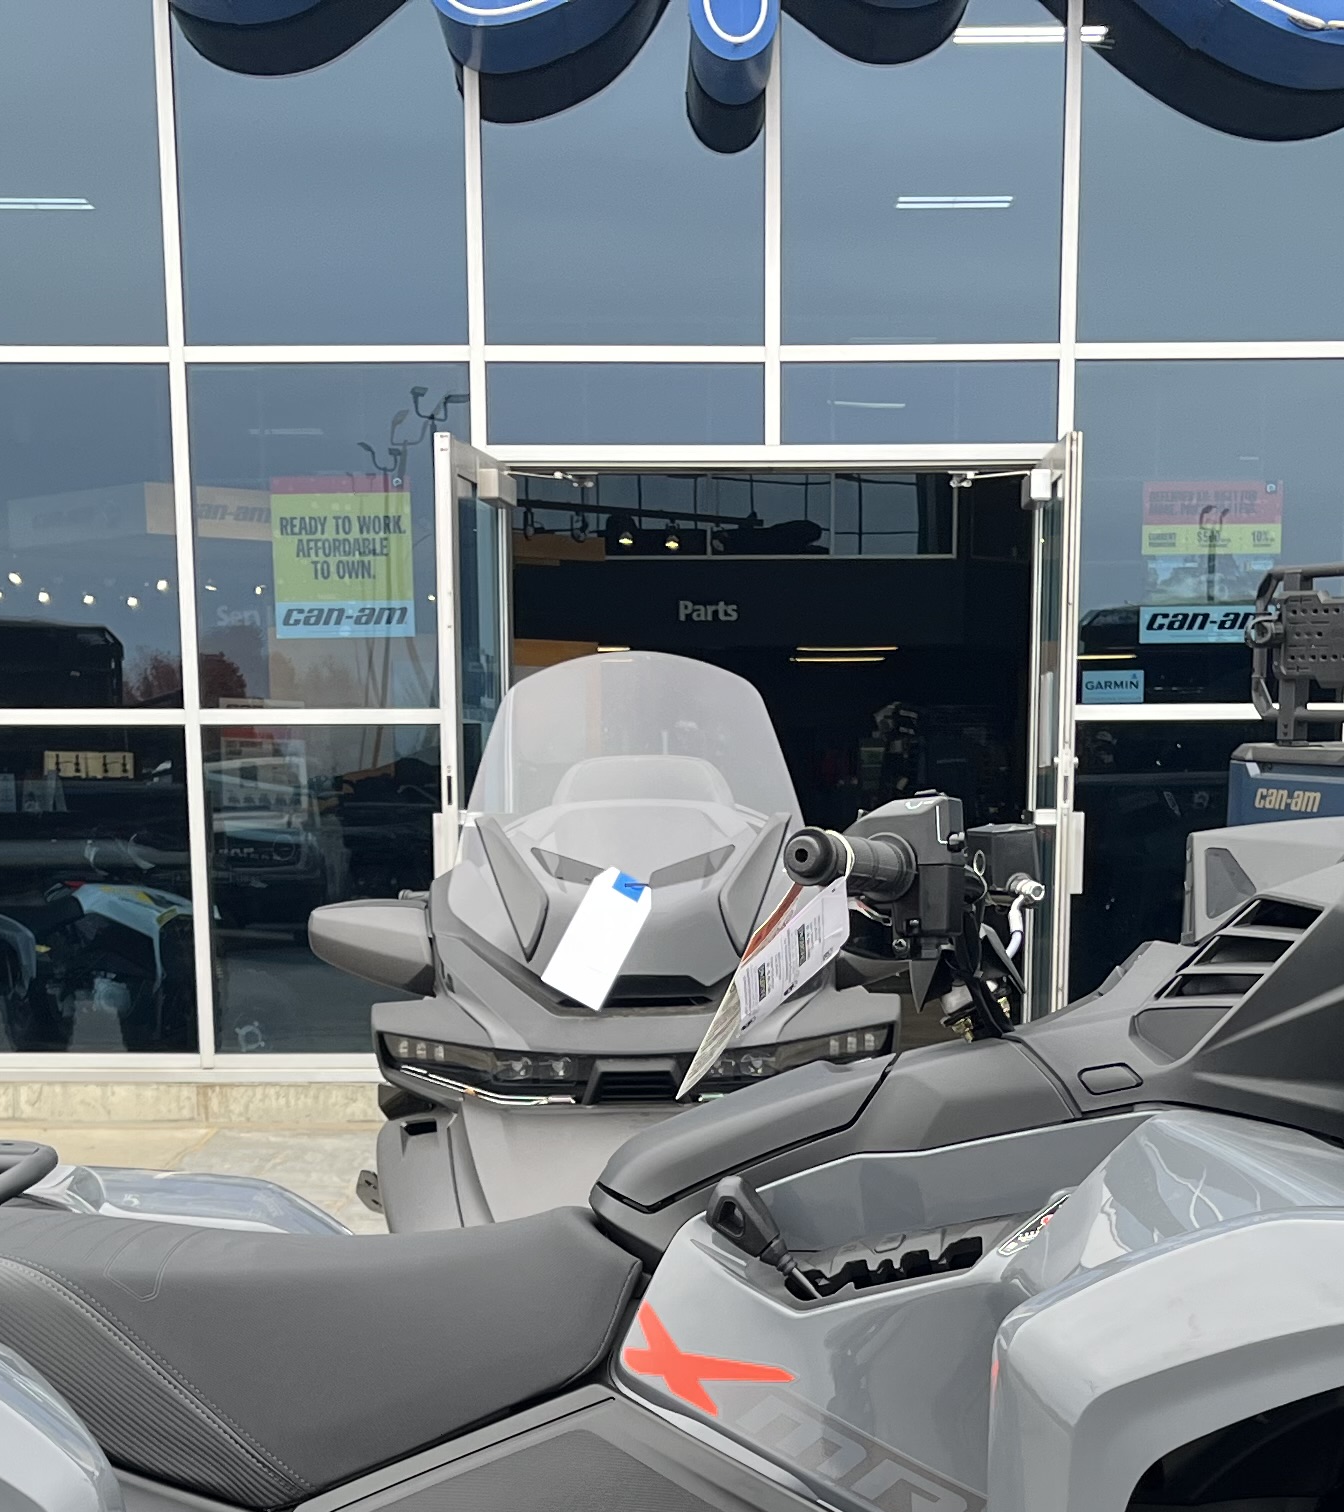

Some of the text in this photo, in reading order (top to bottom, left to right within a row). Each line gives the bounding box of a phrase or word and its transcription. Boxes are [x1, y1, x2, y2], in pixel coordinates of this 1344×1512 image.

[279, 515, 406, 535] READY TO WORK.
[296, 538, 389, 558] AFFORDABLE
[311, 560, 376, 580] TO OWN.
[282, 606, 409, 627] can-am
[679, 600, 739, 621] Parts
[1085, 679, 1139, 691] GARMIN
[1255, 788, 1321, 812] can-am
